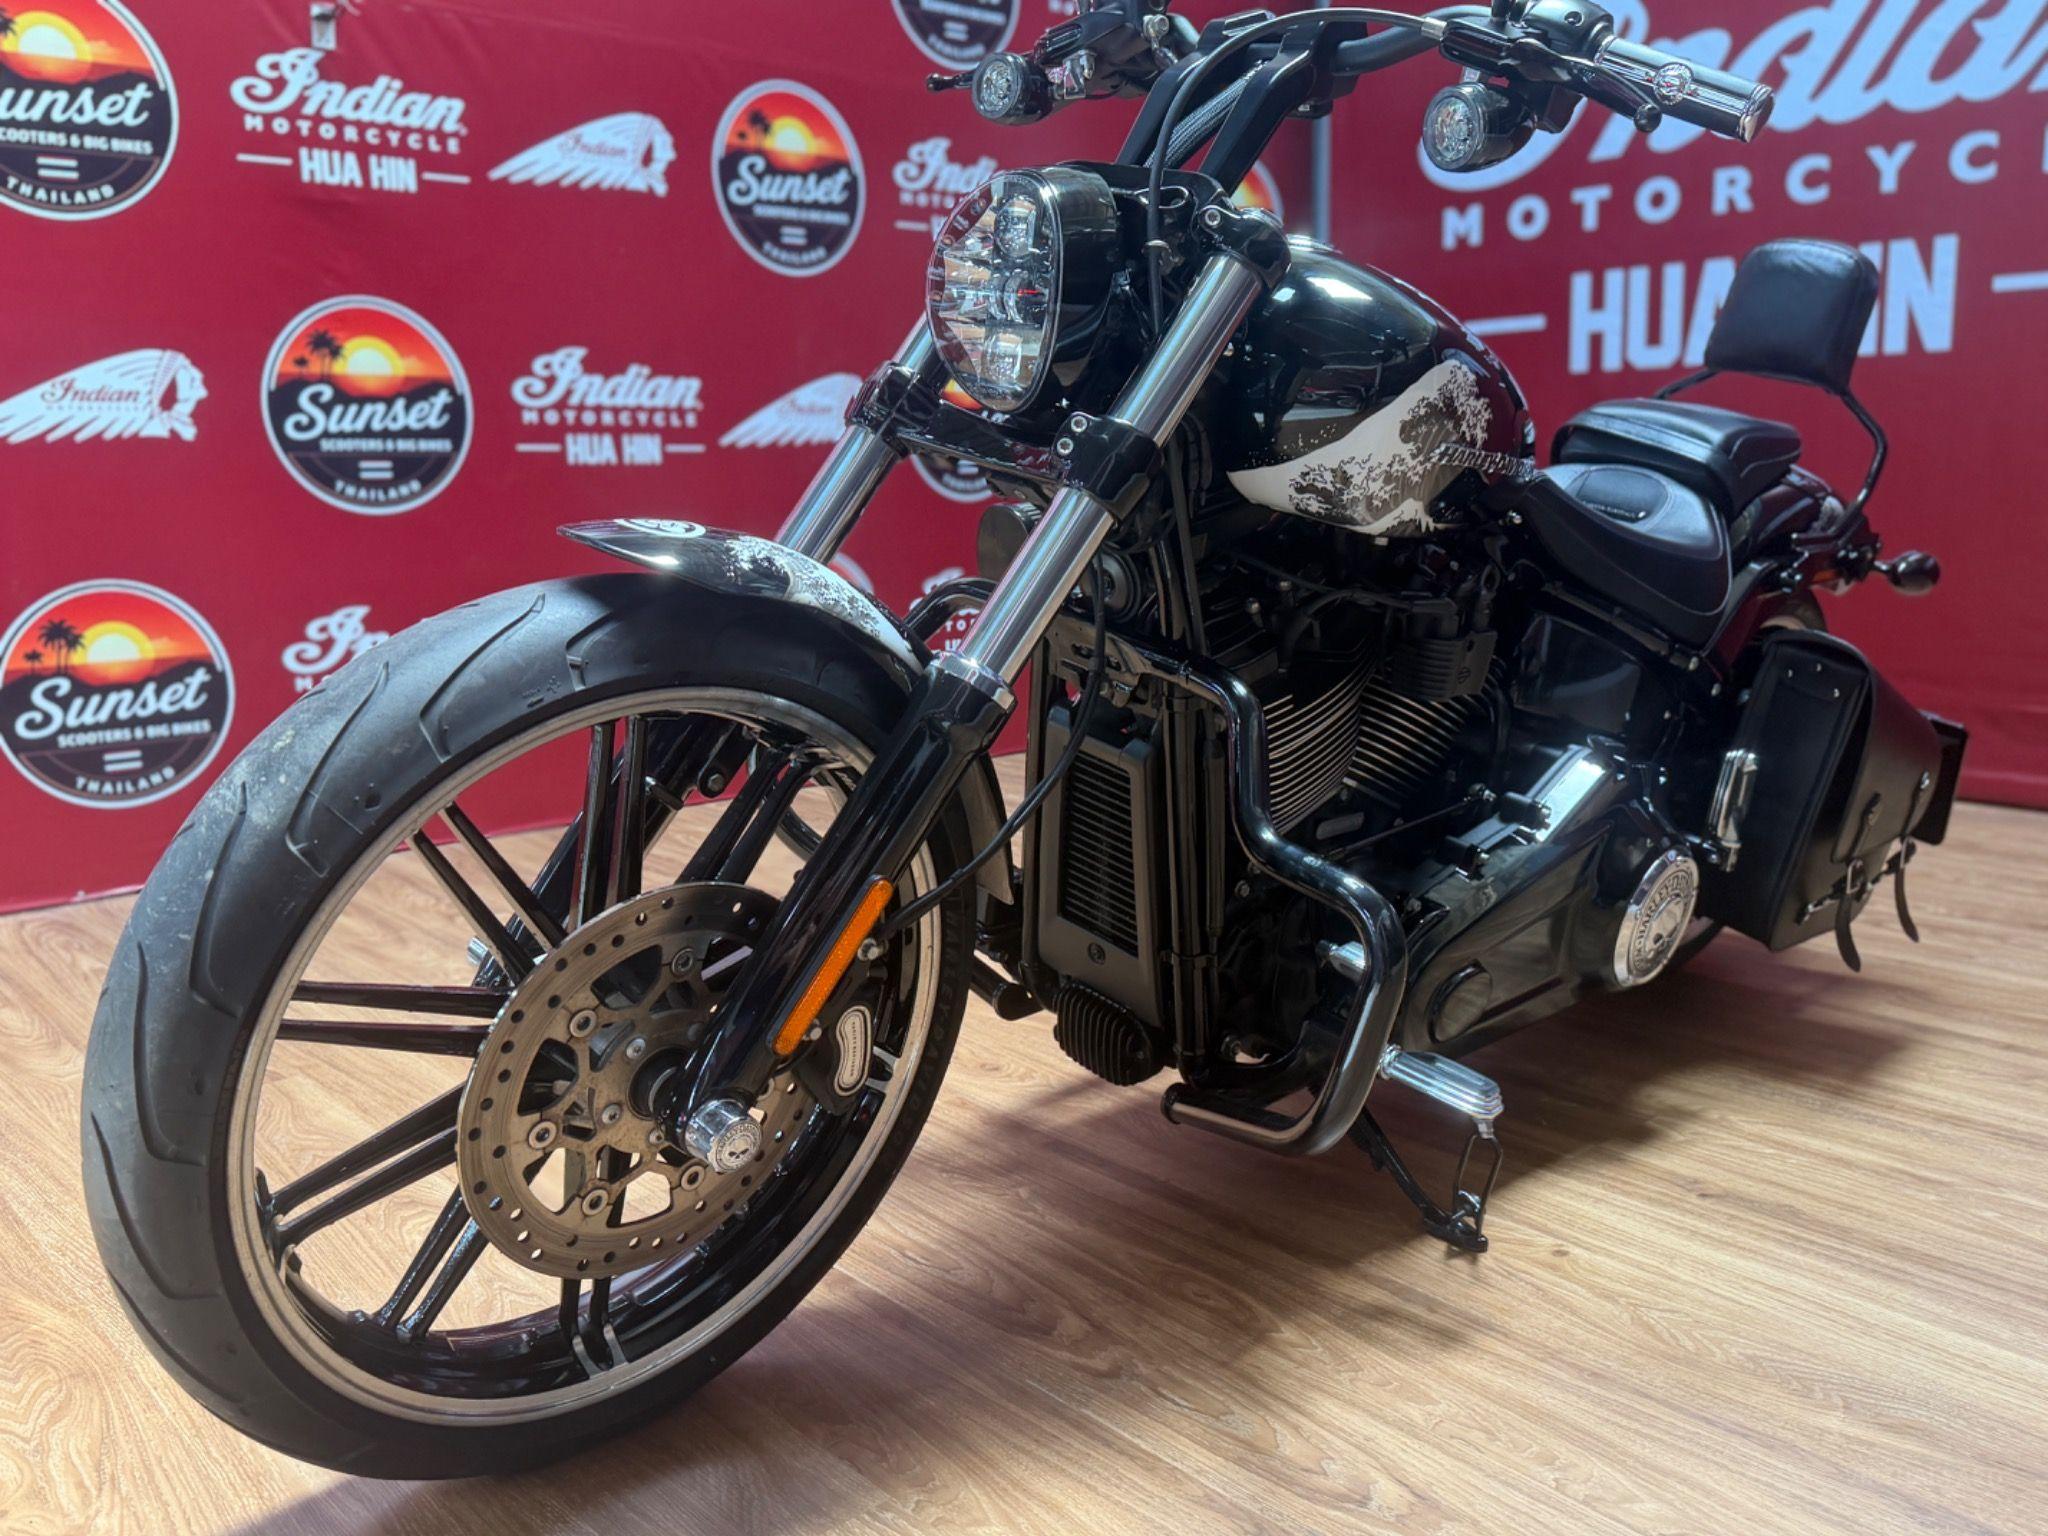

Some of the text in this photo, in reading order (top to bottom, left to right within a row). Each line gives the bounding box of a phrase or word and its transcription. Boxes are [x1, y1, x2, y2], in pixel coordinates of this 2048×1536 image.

[0, 82, 153, 127] unset
[230, 47, 466, 134] Indian
[1418, 0, 2048, 191] ndia
[0, 126, 68, 147] COOTERS
[82, 134, 109, 152] BIG
[243, 113, 461, 155] MOTORCYCLE
[7, 175, 115, 205] THAILAND
[299, 147, 418, 194] HUA HIN
[727, 154, 850, 206] Sunset
[1441, 122, 2048, 251] MOTORCYC
[41, 376, 141, 403] Indian
[511, 346, 703, 410] Indian
[283, 383, 454, 441] Sunset
[521, 407, 698, 428] MOTORCYCLE
[565, 433, 663, 466] HUA HIN
[335, 479, 421, 502] THAILAND
[14, 667, 212, 740] Sunset
[57, 727, 132, 749] SCOOTERS
[146, 722, 170, 739] BIG
[171, 718, 211, 736] BIKES
[75, 765, 175, 795] THAILAND
